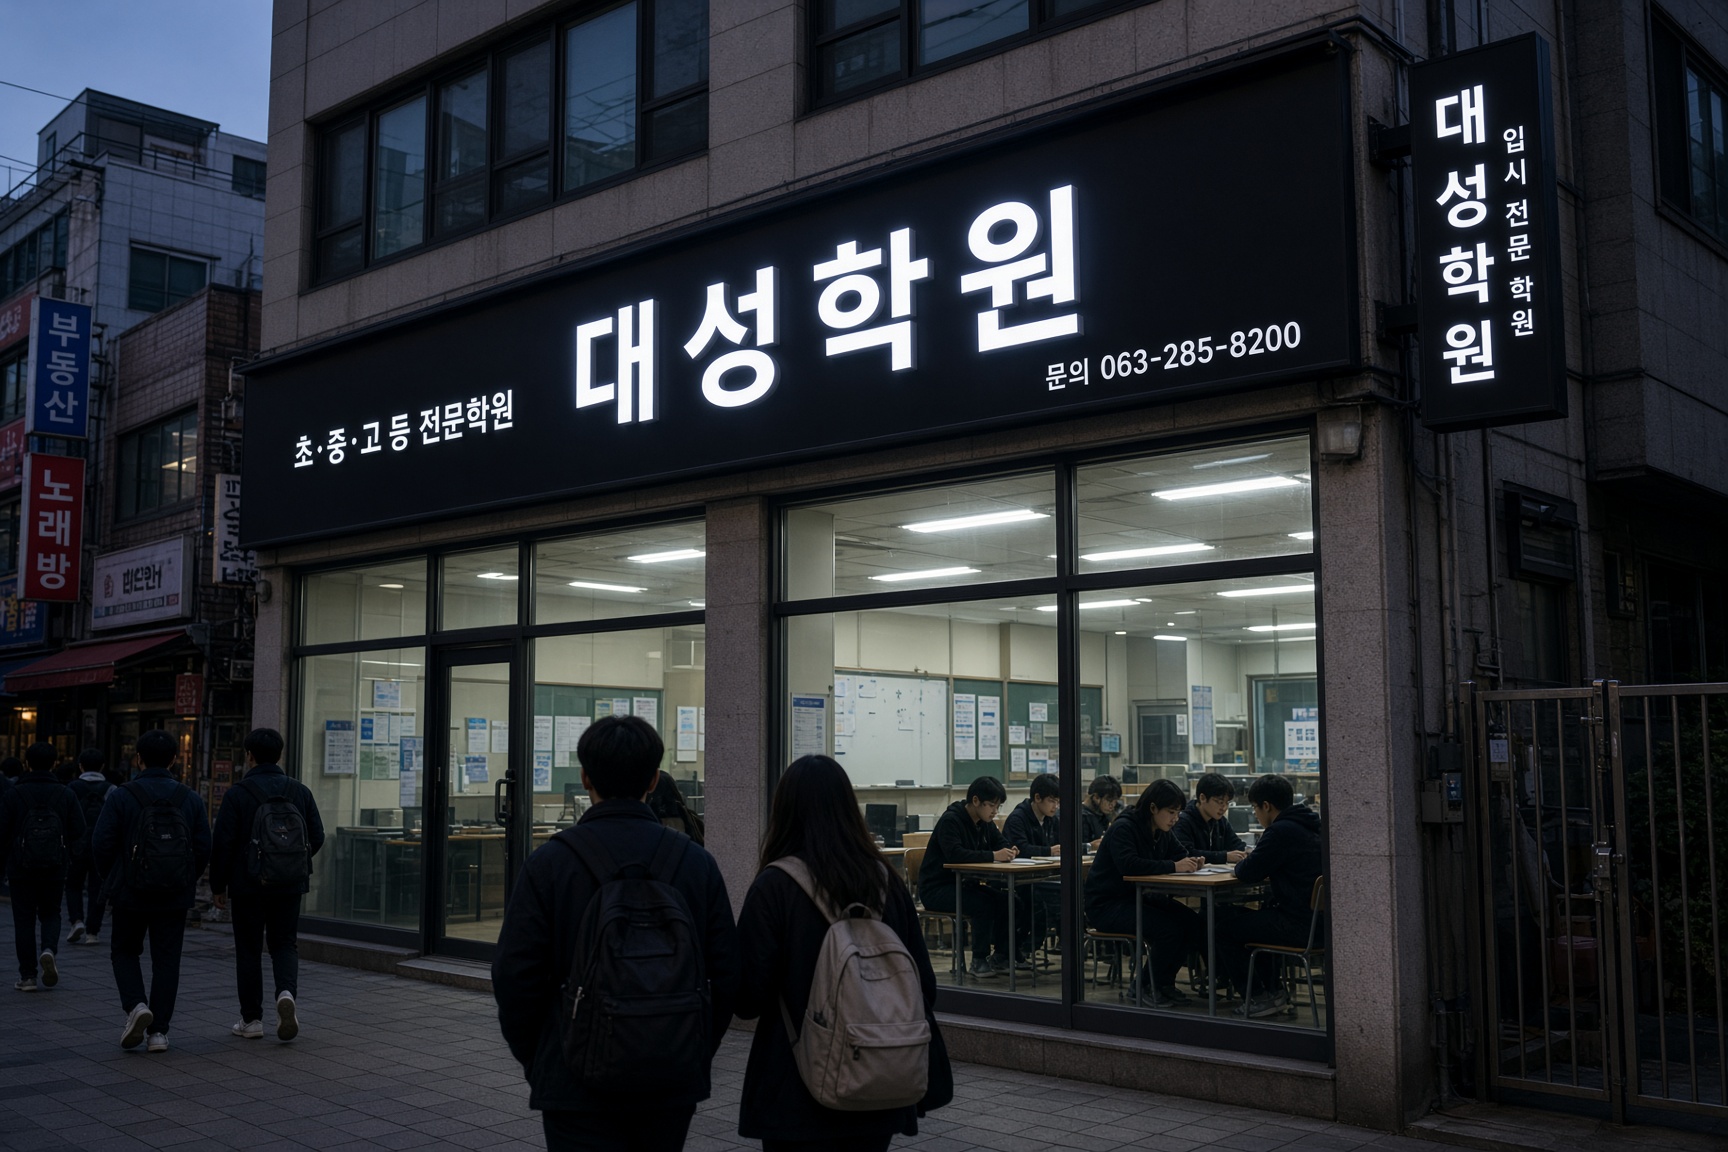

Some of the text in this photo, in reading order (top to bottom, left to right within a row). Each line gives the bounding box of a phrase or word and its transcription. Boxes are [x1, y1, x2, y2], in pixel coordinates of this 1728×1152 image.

[1435, 84, 1495, 385] 대성학원
[1503, 125, 1534, 337] 입시 전문 학원
[575, 184, 1083, 425] 대성학원
[1045, 321, 1302, 391] 문의 063-285-8200
[44, 312, 80, 424] 부동산
[418, 389, 513, 445] 전문학원
[37, 468, 74, 590] 노래방
